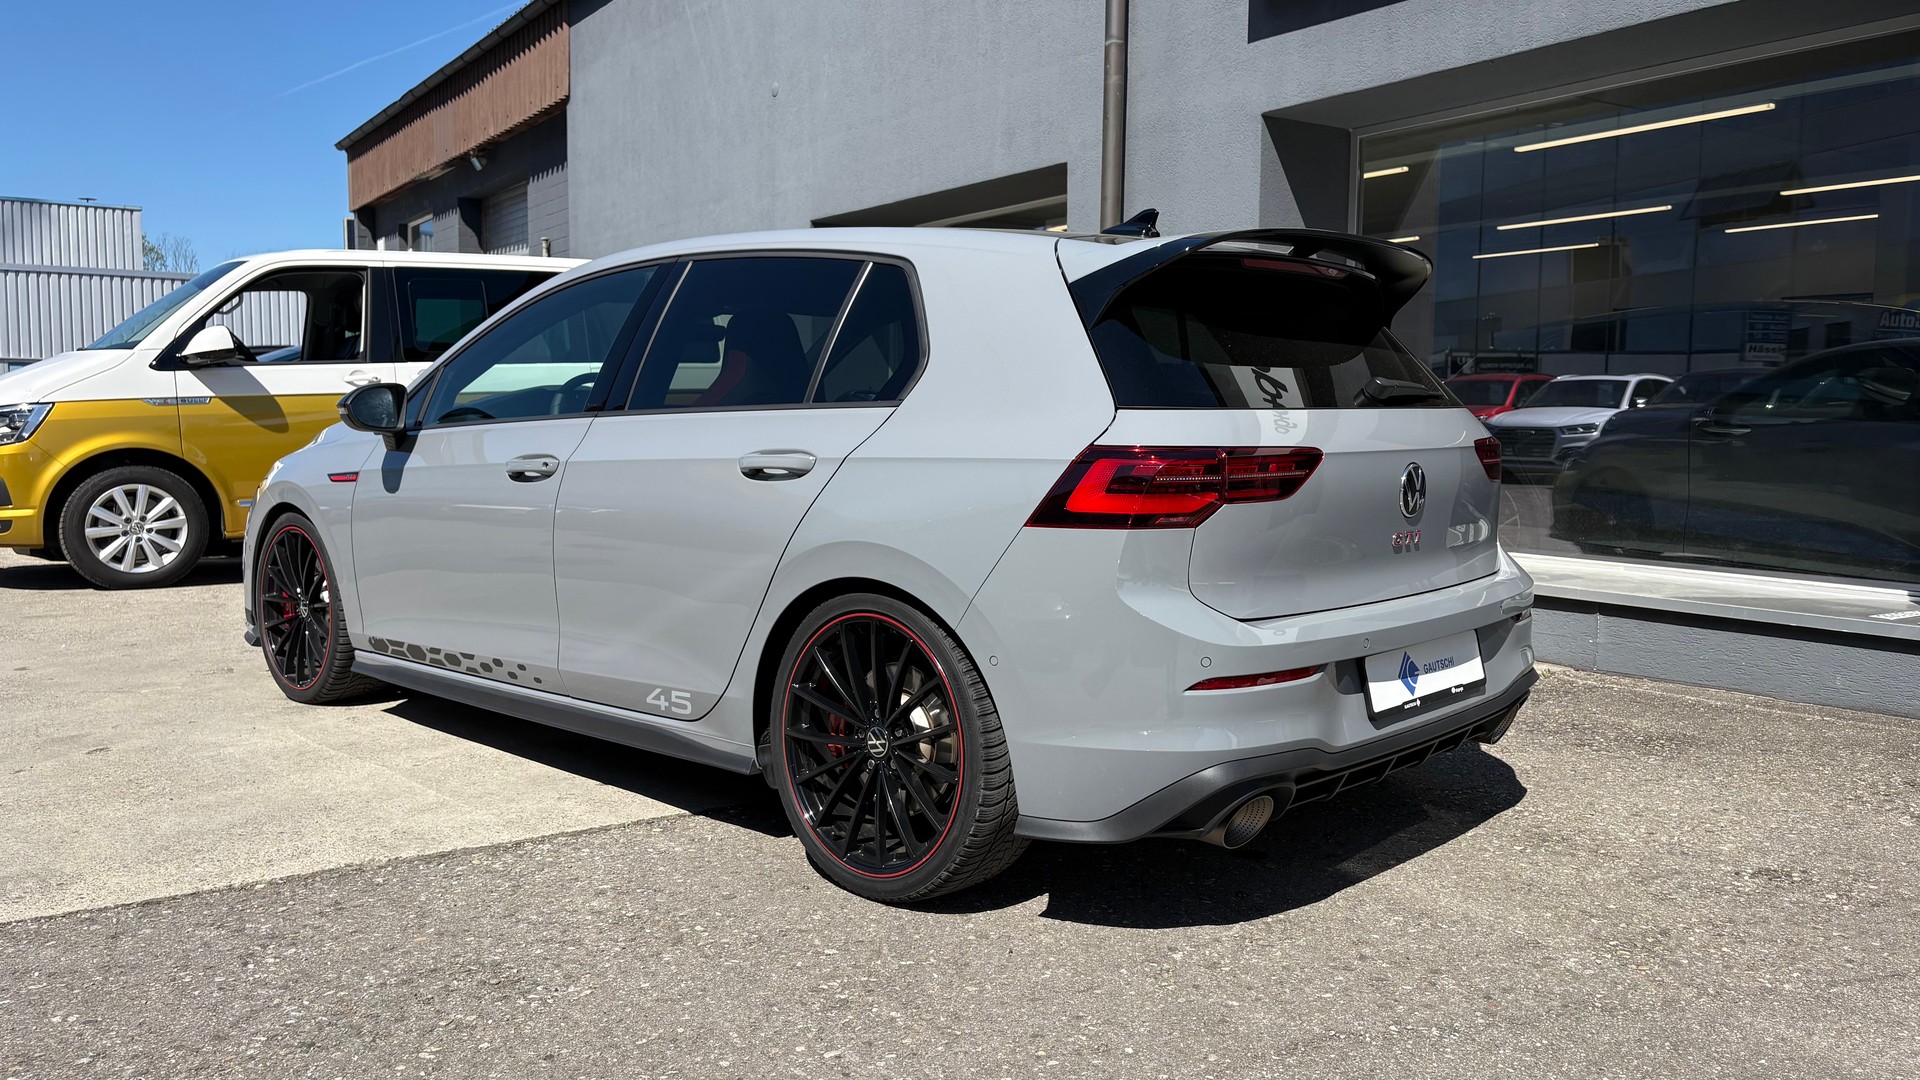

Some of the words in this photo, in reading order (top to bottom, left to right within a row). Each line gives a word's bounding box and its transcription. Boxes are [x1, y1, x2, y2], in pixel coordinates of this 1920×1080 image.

[1392, 529, 1422, 547] GTI
[1423, 656, 1455, 674] GAUTSCHI
[646, 688, 692, 715] 45
